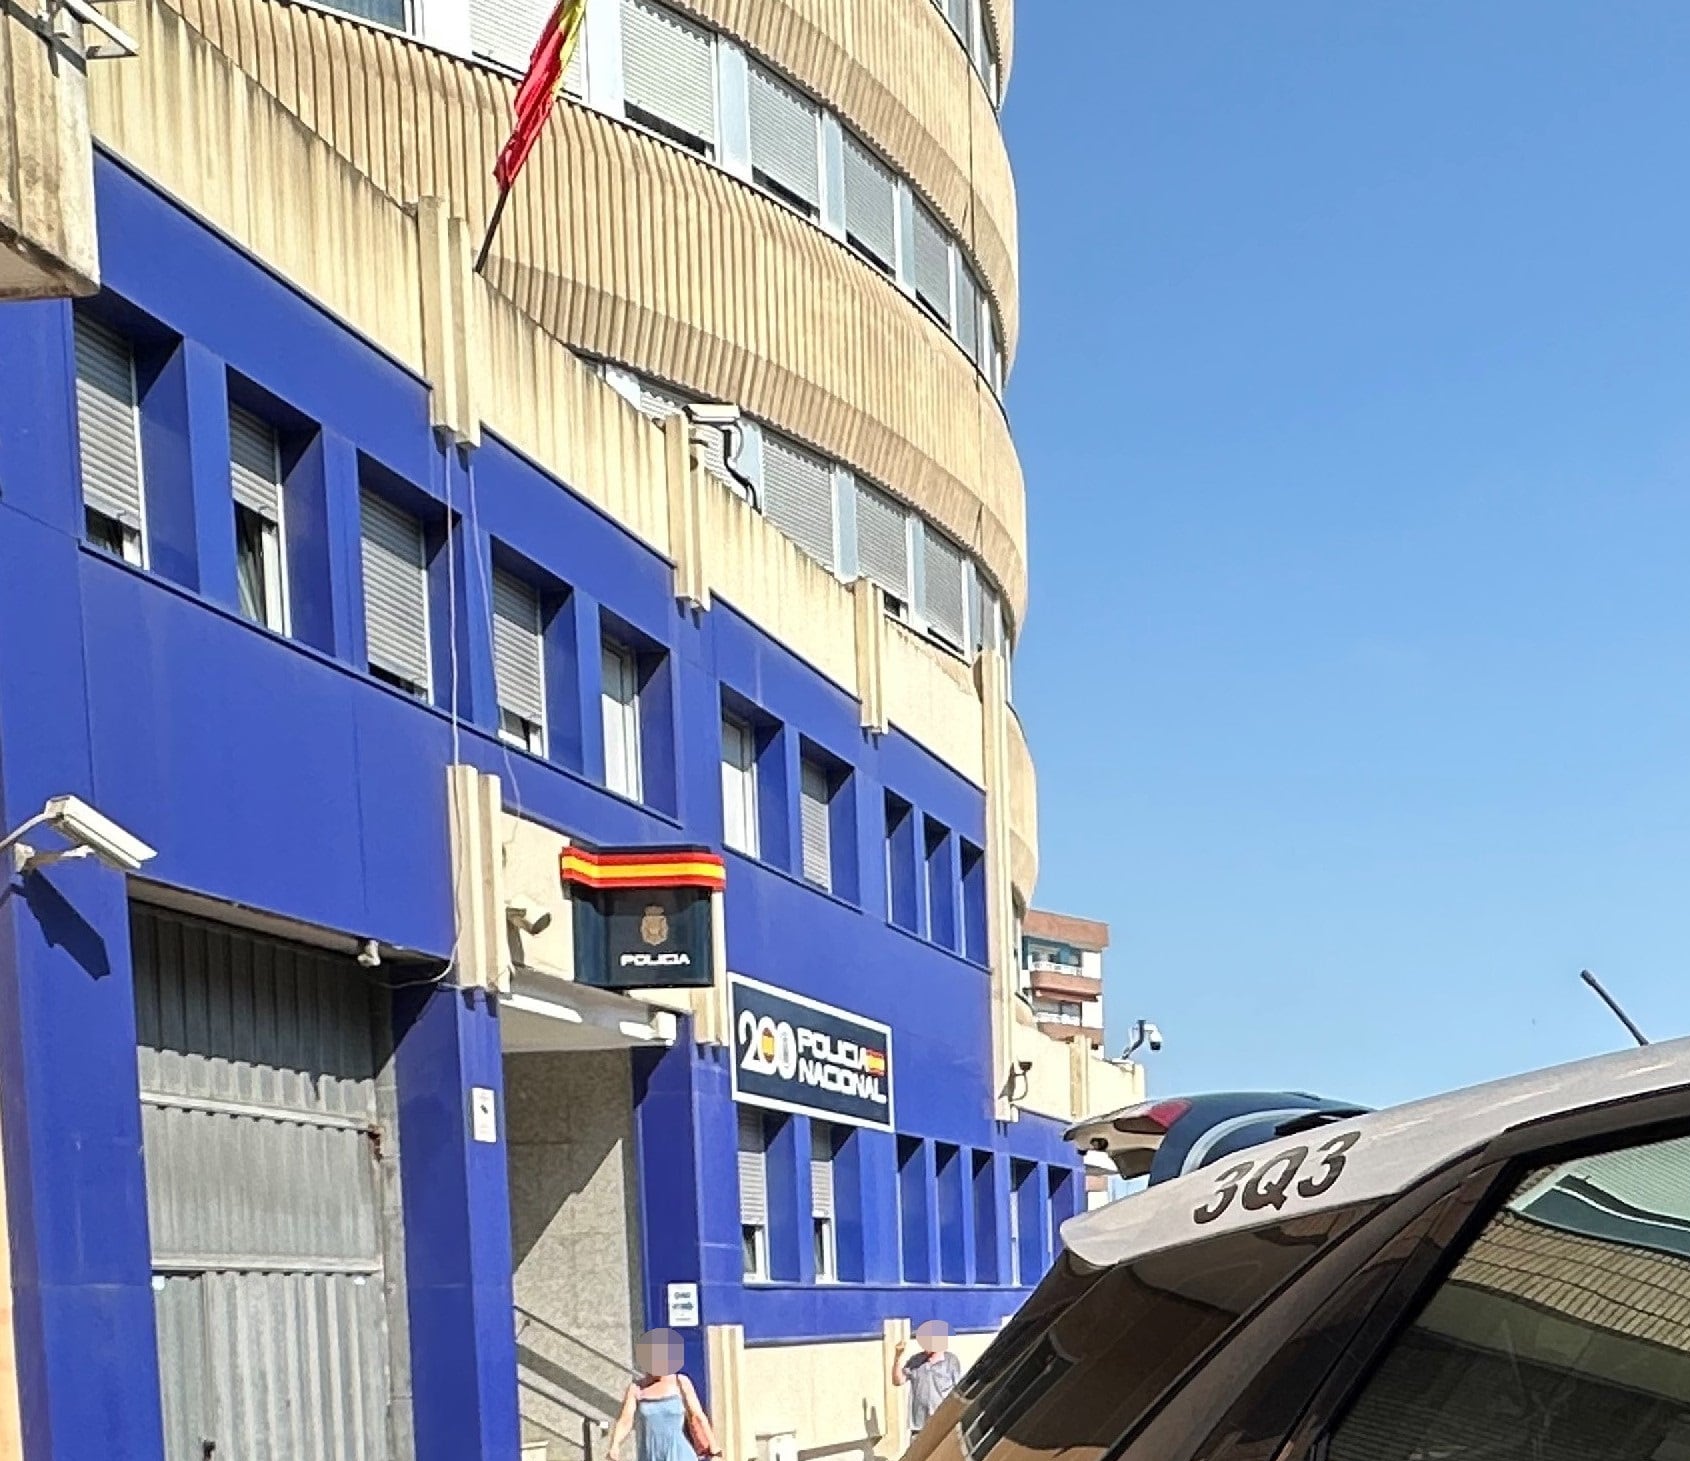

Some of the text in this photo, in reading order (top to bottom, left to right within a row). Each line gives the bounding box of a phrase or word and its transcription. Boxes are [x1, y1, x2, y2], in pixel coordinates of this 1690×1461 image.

[738, 1009, 797, 1080] 200
[798, 1057, 887, 1105] NACIONAL
[1193, 1131, 1361, 1224] 3Q3
